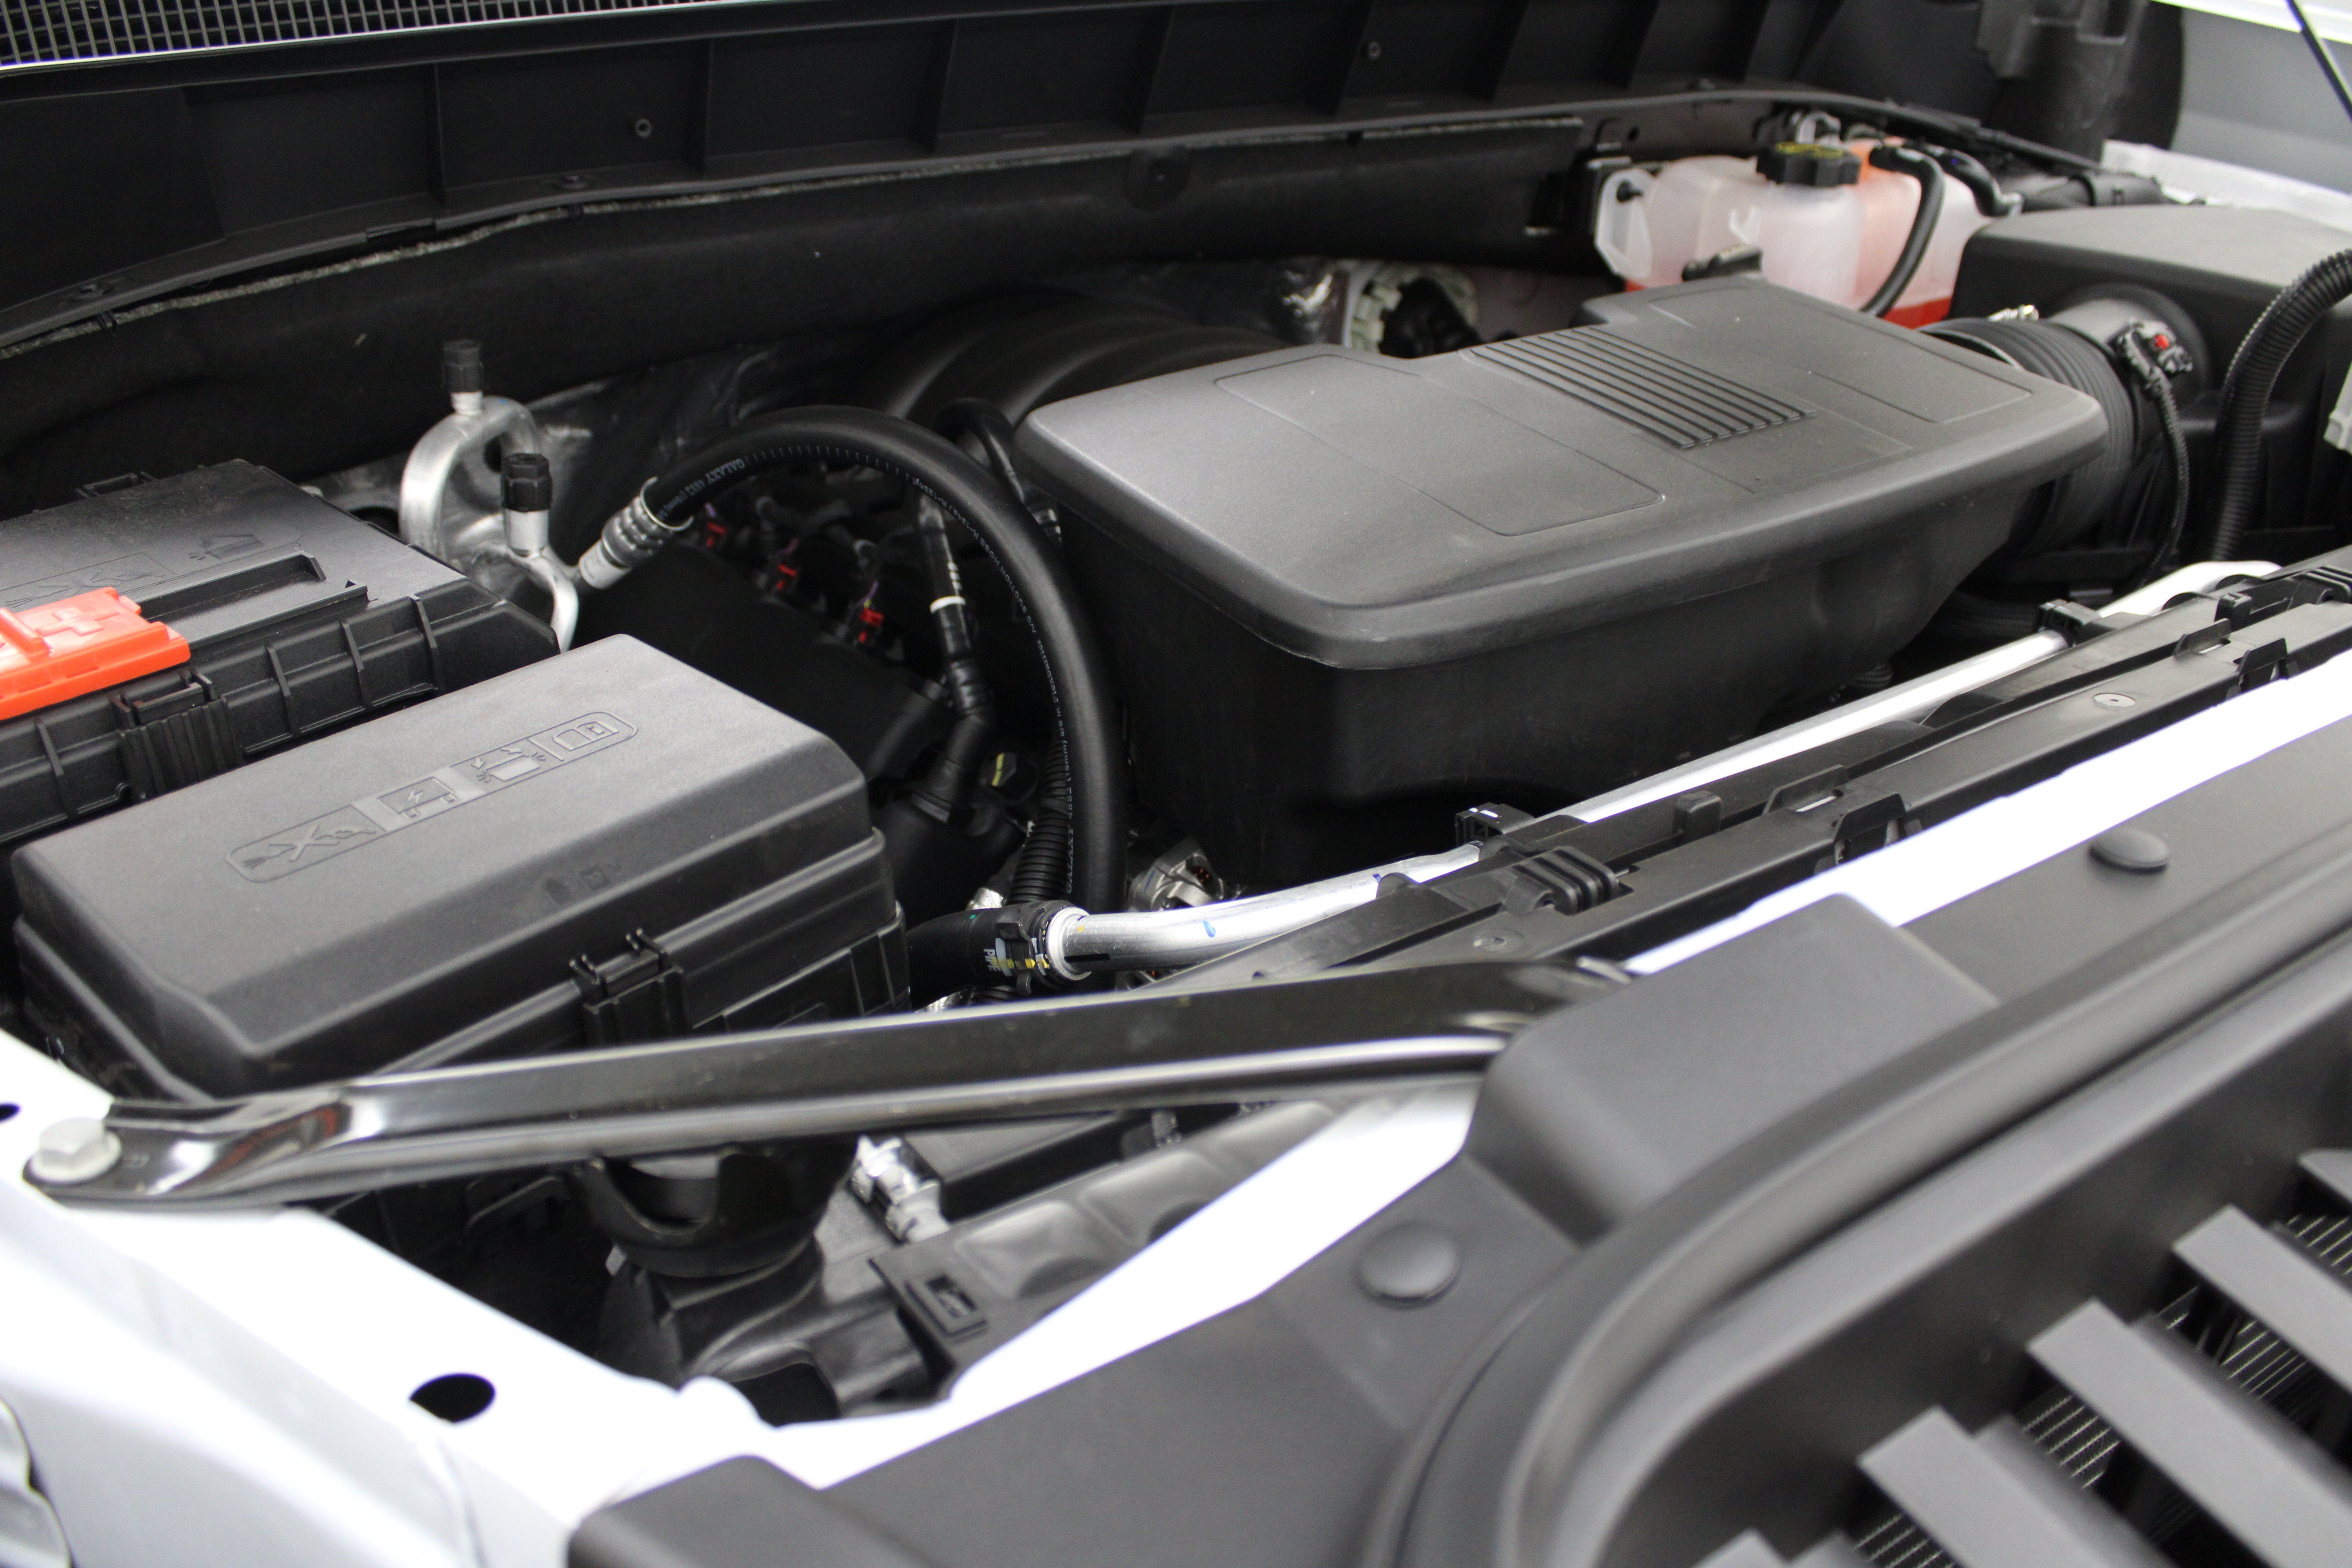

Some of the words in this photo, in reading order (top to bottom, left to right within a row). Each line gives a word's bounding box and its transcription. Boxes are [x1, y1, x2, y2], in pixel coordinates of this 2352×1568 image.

[706, 458, 746, 484] GALAXY
[980, 537, 1000, 566] HOSE
[1000, 566, 1027, 613] SUCTION
[983, 949, 1002, 971] PIPE
